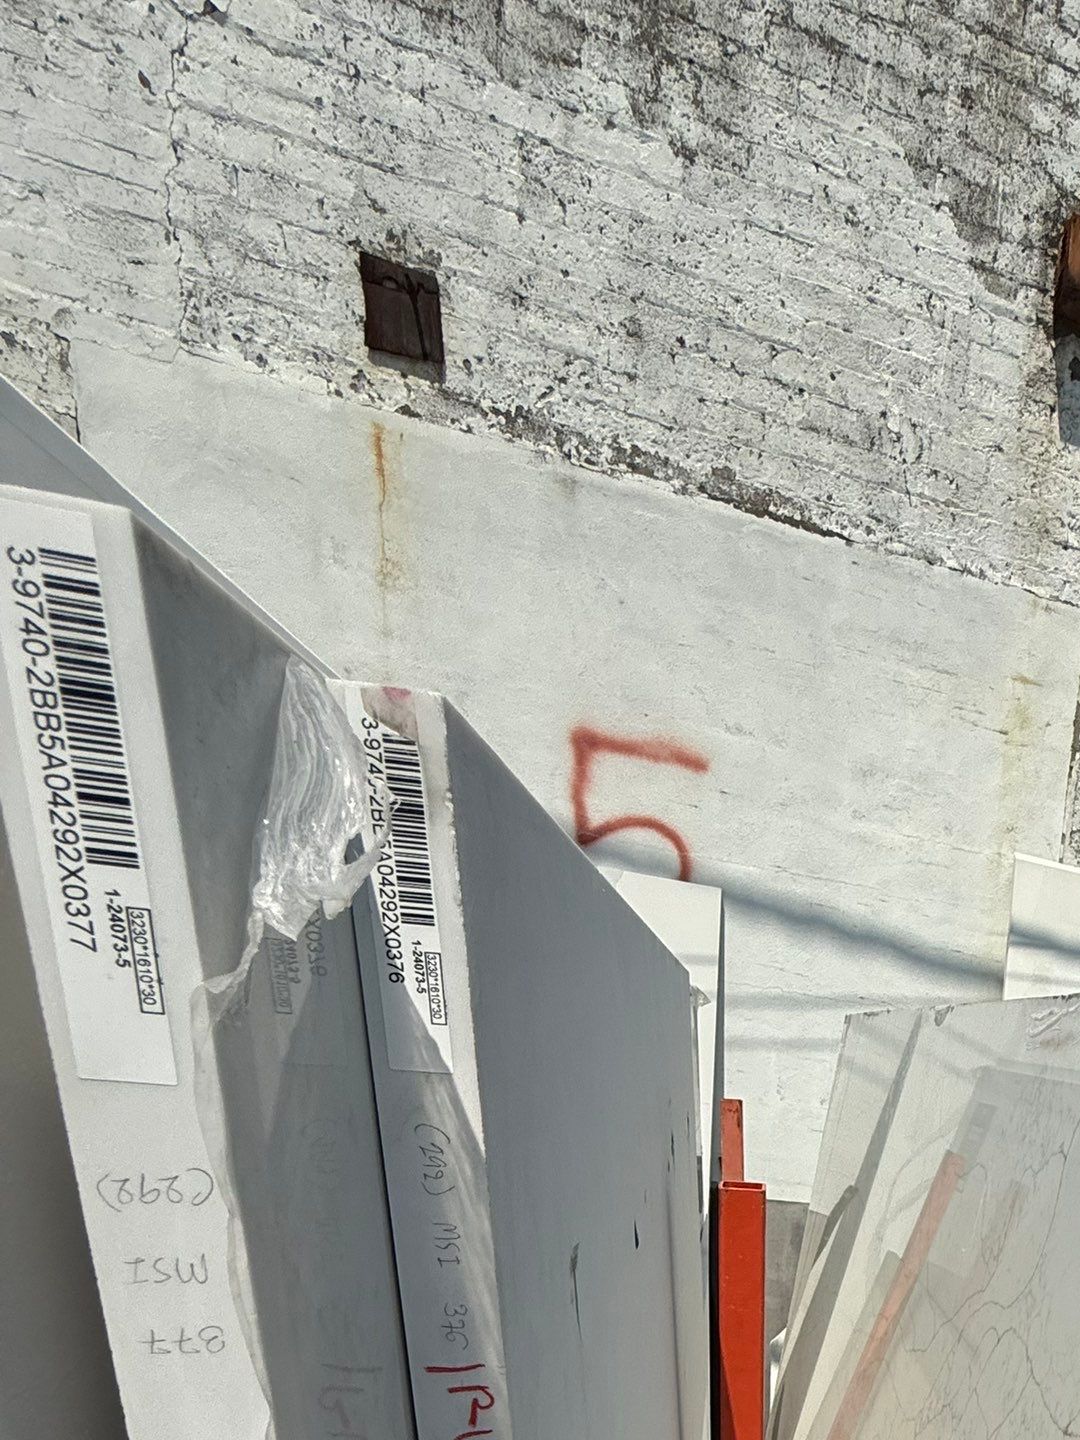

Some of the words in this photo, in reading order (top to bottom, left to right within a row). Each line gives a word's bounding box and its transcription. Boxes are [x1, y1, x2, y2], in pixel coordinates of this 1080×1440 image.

[6, 546, 98, 953] 3-9740-2BB5A04292X0377
[570, 725, 711, 881] 5
[103, 888, 132, 969] 1-24073-5
[411, 939, 427, 995] 1-24073-5
[123, 1254, 210, 1285] MSI
[432, 1222, 462, 1268] MSI
